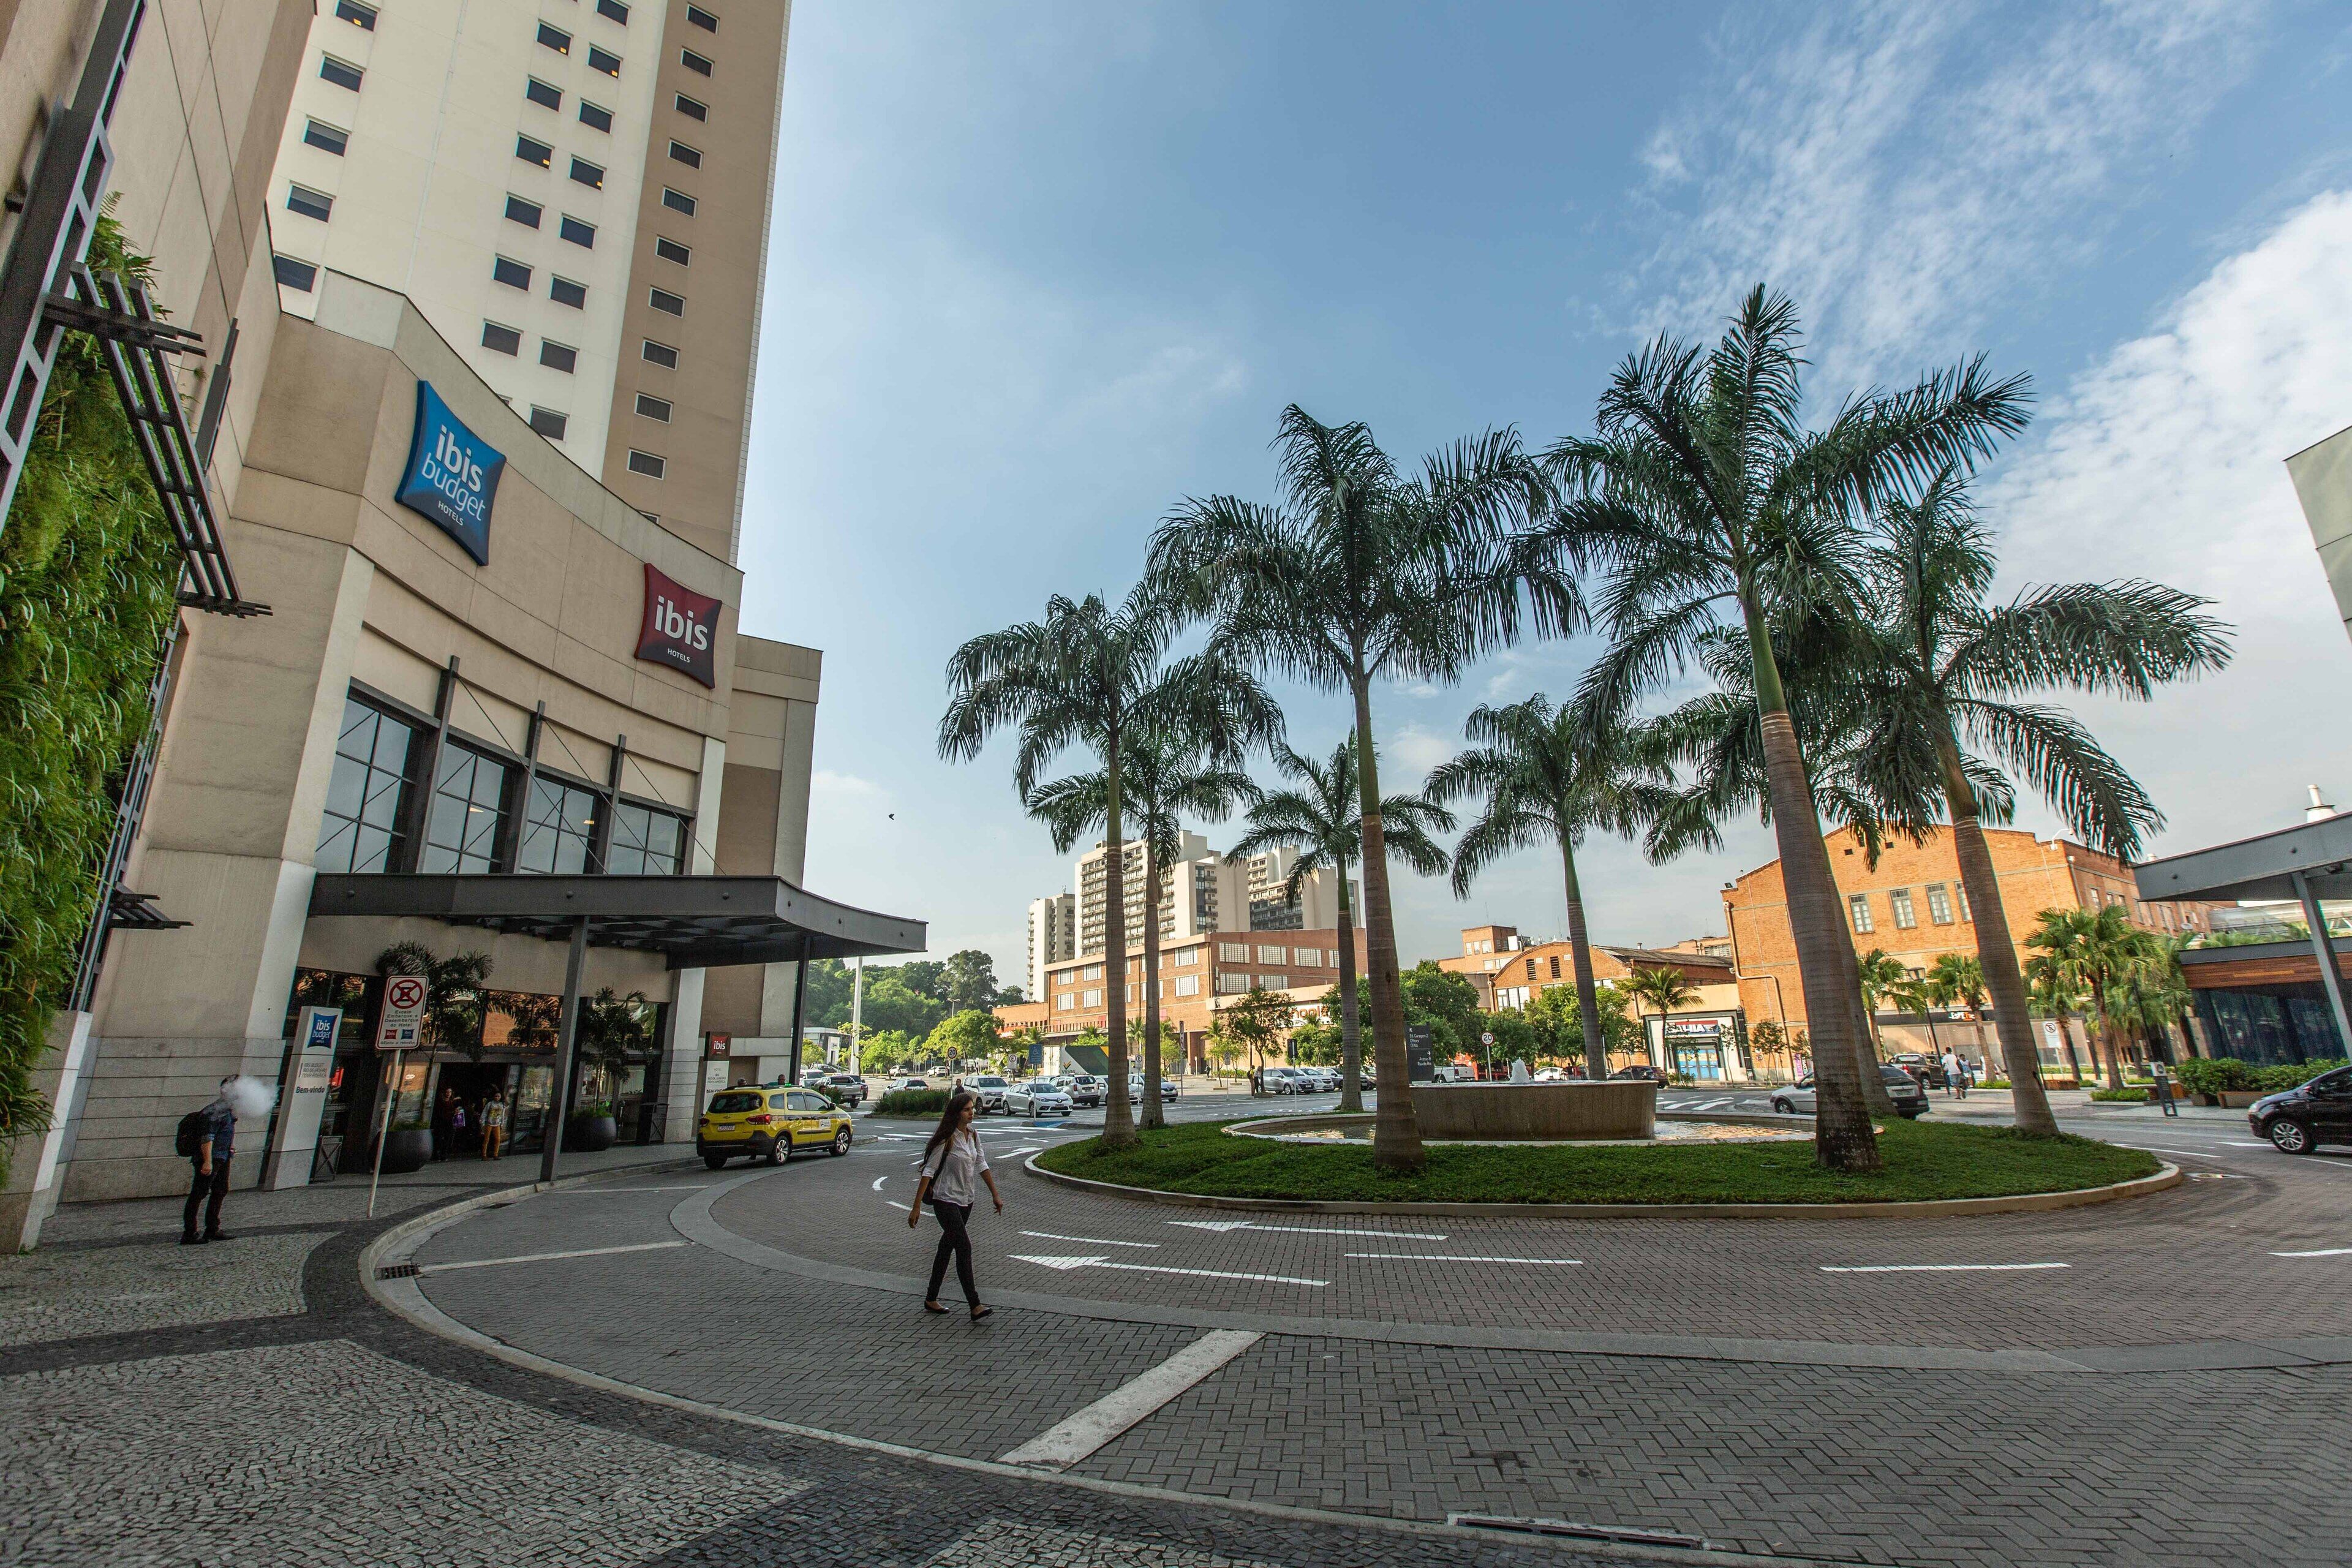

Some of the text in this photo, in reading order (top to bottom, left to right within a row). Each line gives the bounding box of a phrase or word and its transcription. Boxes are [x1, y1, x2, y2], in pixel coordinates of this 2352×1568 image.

[436, 424, 483, 492] ibis
[421, 452, 486, 521] budget
[438, 500, 464, 526] HOTELS
[655, 595, 707, 650] ibis
[667, 648, 690, 663] HOTELS
[312, 1030, 331, 1039] budget
[316, 1020, 330, 1030] ibis
[714, 1041, 726, 1050] ibis
